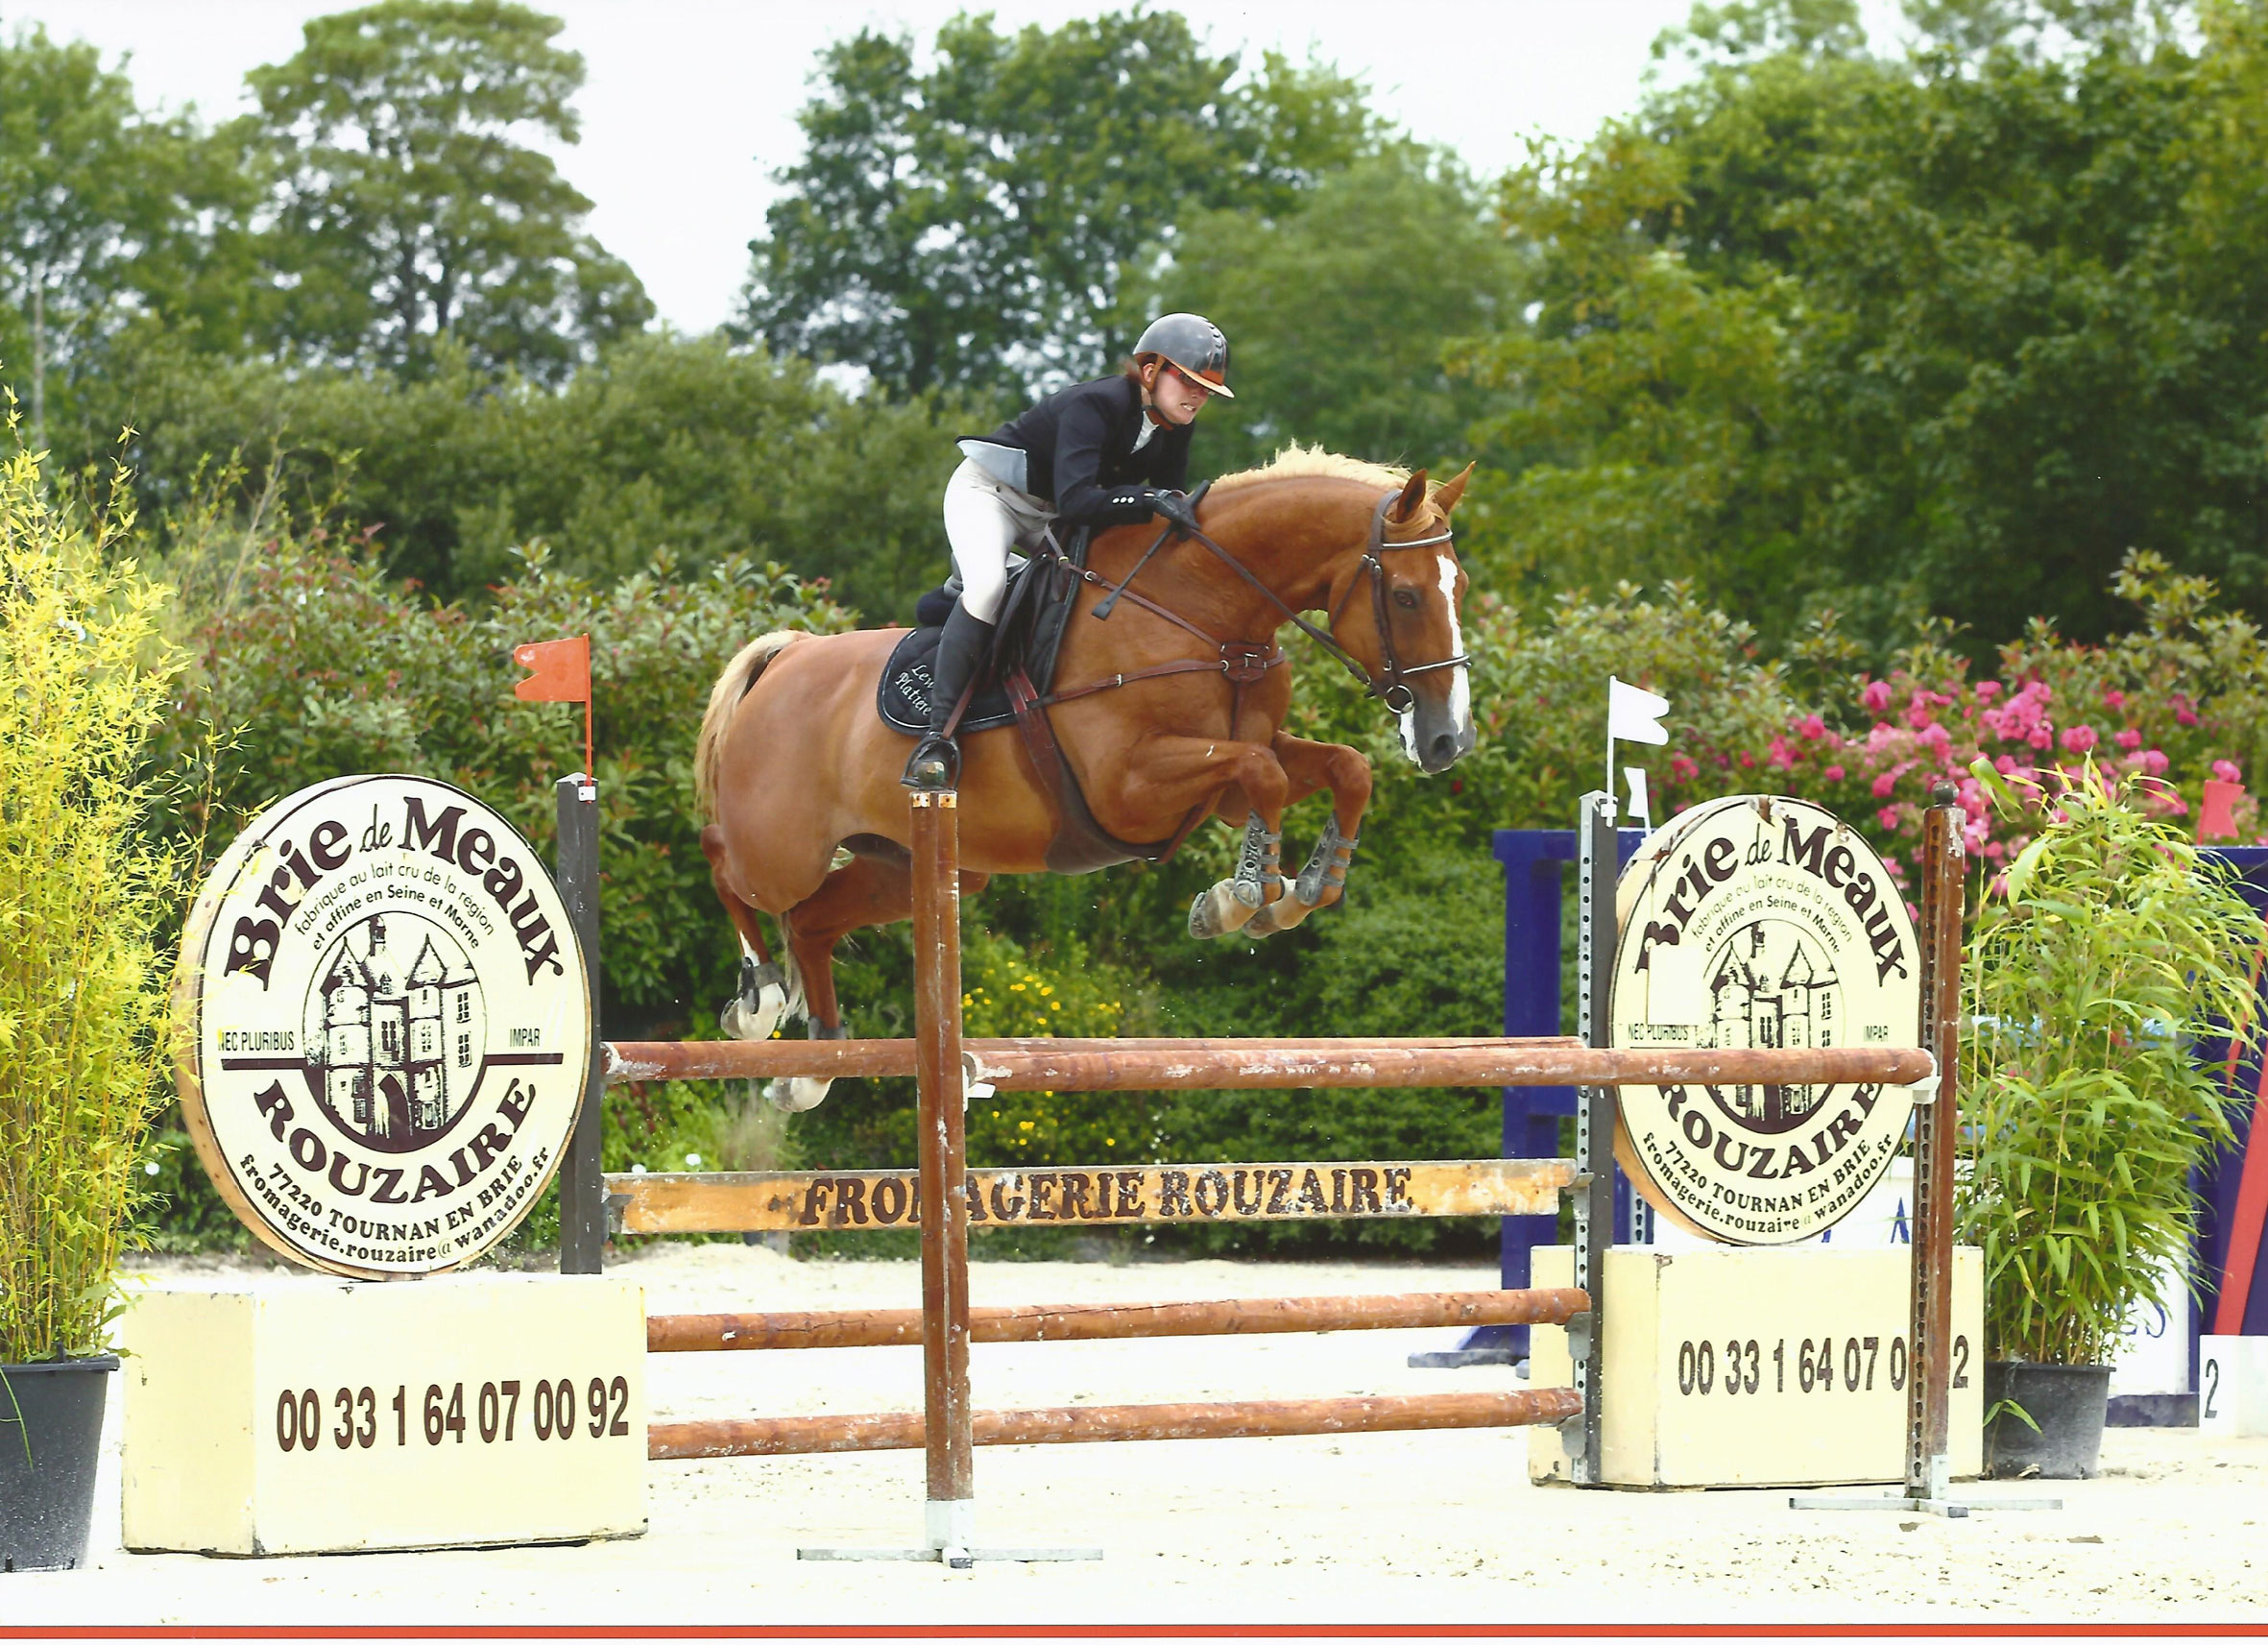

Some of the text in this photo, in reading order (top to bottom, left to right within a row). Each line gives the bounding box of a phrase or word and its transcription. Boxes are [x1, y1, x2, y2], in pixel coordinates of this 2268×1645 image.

[224, 796, 564, 992] Brie de Meaux
[350, 871, 367, 886] au
[371, 861, 393, 879] lait
[398, 865, 419, 879] cru
[423, 866, 441, 885] de
[445, 875, 456, 894] la
[1735, 882, 1750, 897] au
[1753, 874, 1772, 889] lait
[1775, 877, 1794, 890] cru
[1797, 880, 1811, 897] de
[1812, 888, 1823, 905] la
[1745, 823, 1772, 865] de
[1776, 814, 1908, 987] Meaux
[313, 932, 325, 950] et
[366, 889, 383, 904] en
[387, 884, 425, 902] Seine
[429, 897, 444, 909] et
[445, 905, 479, 949] Marne
[1705, 936, 1716, 953] et
[1749, 899, 1764, 911] en
[1767, 895, 1798, 911] Seine
[1800, 906, 1811, 919] et
[1812, 914, 1840, 954] Marne
[241, 1030, 295, 1052] PLURIBUS
[509, 1028, 541, 1048] IMPAR
[1629, 1023, 1644, 1040] NEC
[1864, 1025, 1889, 1043] IMPAR
[253, 1077, 536, 1203] ROUZAIRE
[268, 1155, 522, 1241] 77220 TOURNAN EN BRIE
[798, 1168, 1417, 1225] FROAGERIE ROUZAIRE
[1665, 1139, 1871, 1212] 77220 TOURNAN EN BRIE
[1678, 1341, 1714, 1395] 00
[1725, 1339, 1759, 1394] 33
[1773, 1339, 1784, 1392] 1
[1798, 1338, 1833, 1393] 64
[1844, 1336, 1879, 1391] 07
[1890, 1336, 1906, 1391] 0
[2205, 1358, 2219, 1418] 2
[277, 1375, 629, 1452] 00 33 1 64 07 00 92
